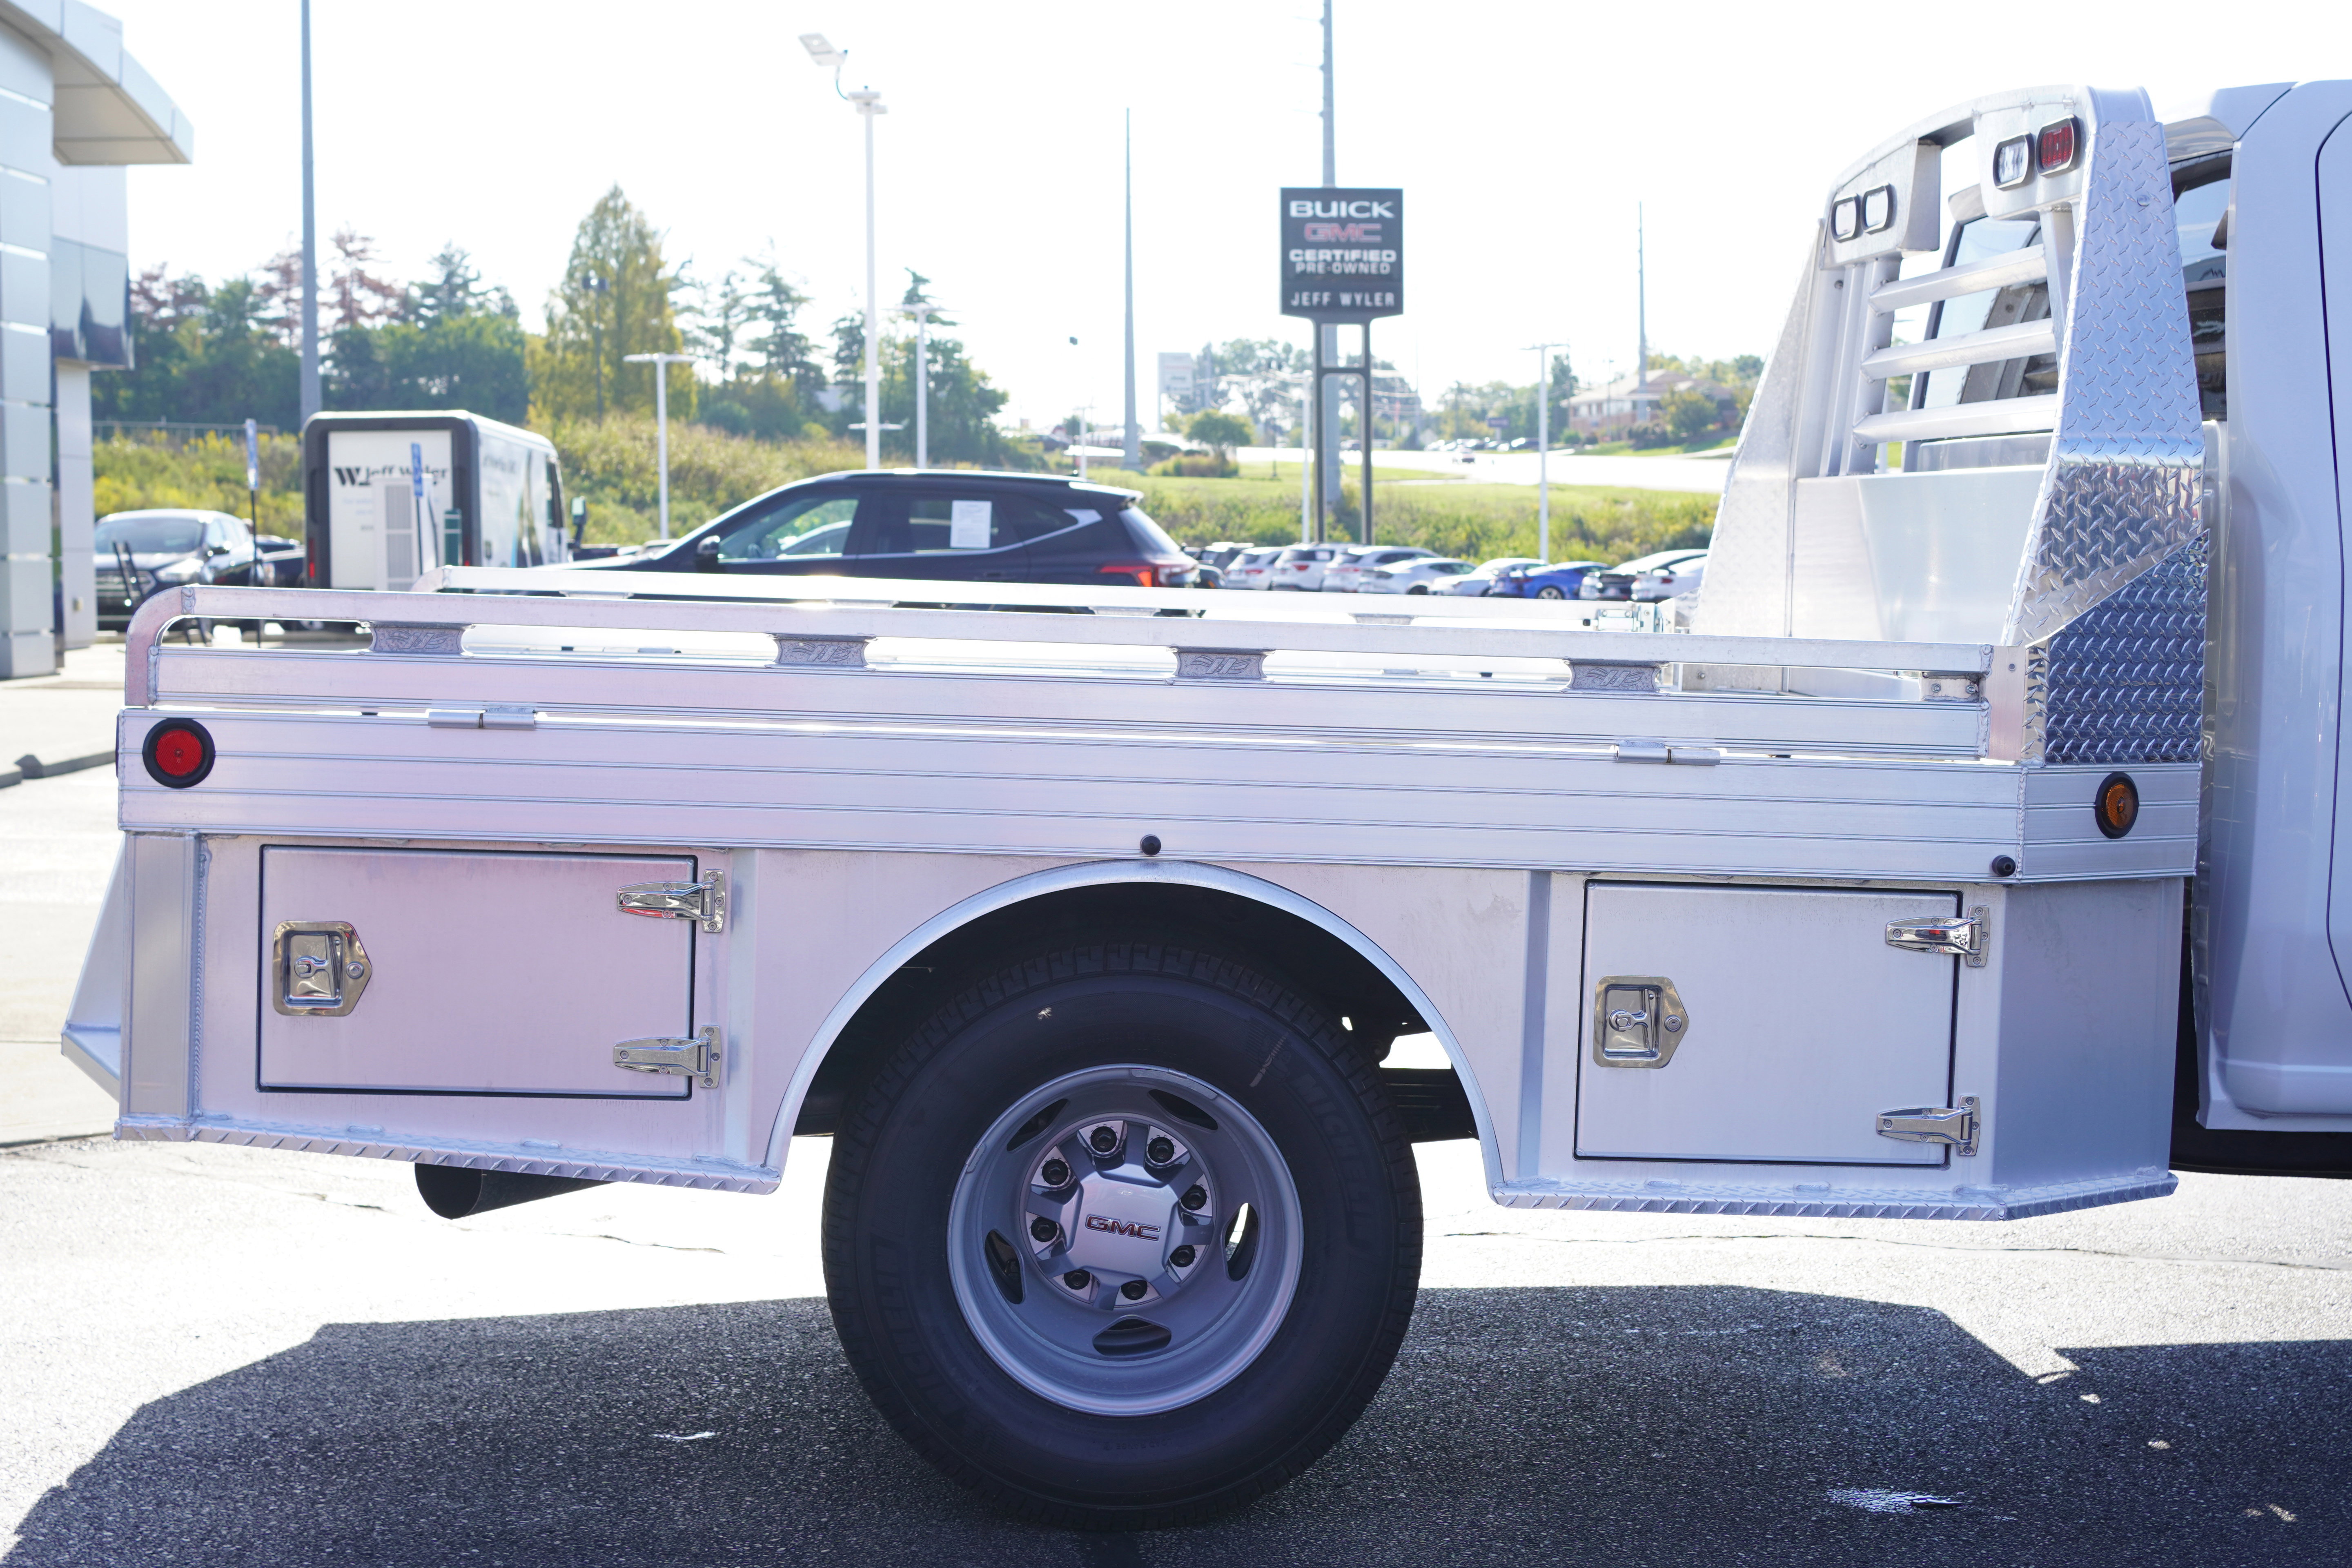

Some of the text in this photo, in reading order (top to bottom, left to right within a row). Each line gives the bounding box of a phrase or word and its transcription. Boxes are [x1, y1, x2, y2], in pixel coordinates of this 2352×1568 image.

[1290, 200, 1394, 218] BUICK
[1305, 223, 1382, 243] GMC
[1289, 249, 1396, 262] CERTIFIED
[1295, 263, 1391, 274] PRE-OWNED
[1291, 292, 1394, 307] JEFF WYLER
[1288, 1067, 1376, 1241] MICHELIN
[1085, 1214, 1161, 1242] GMC
[870, 1243, 967, 1421] MICHELIN
